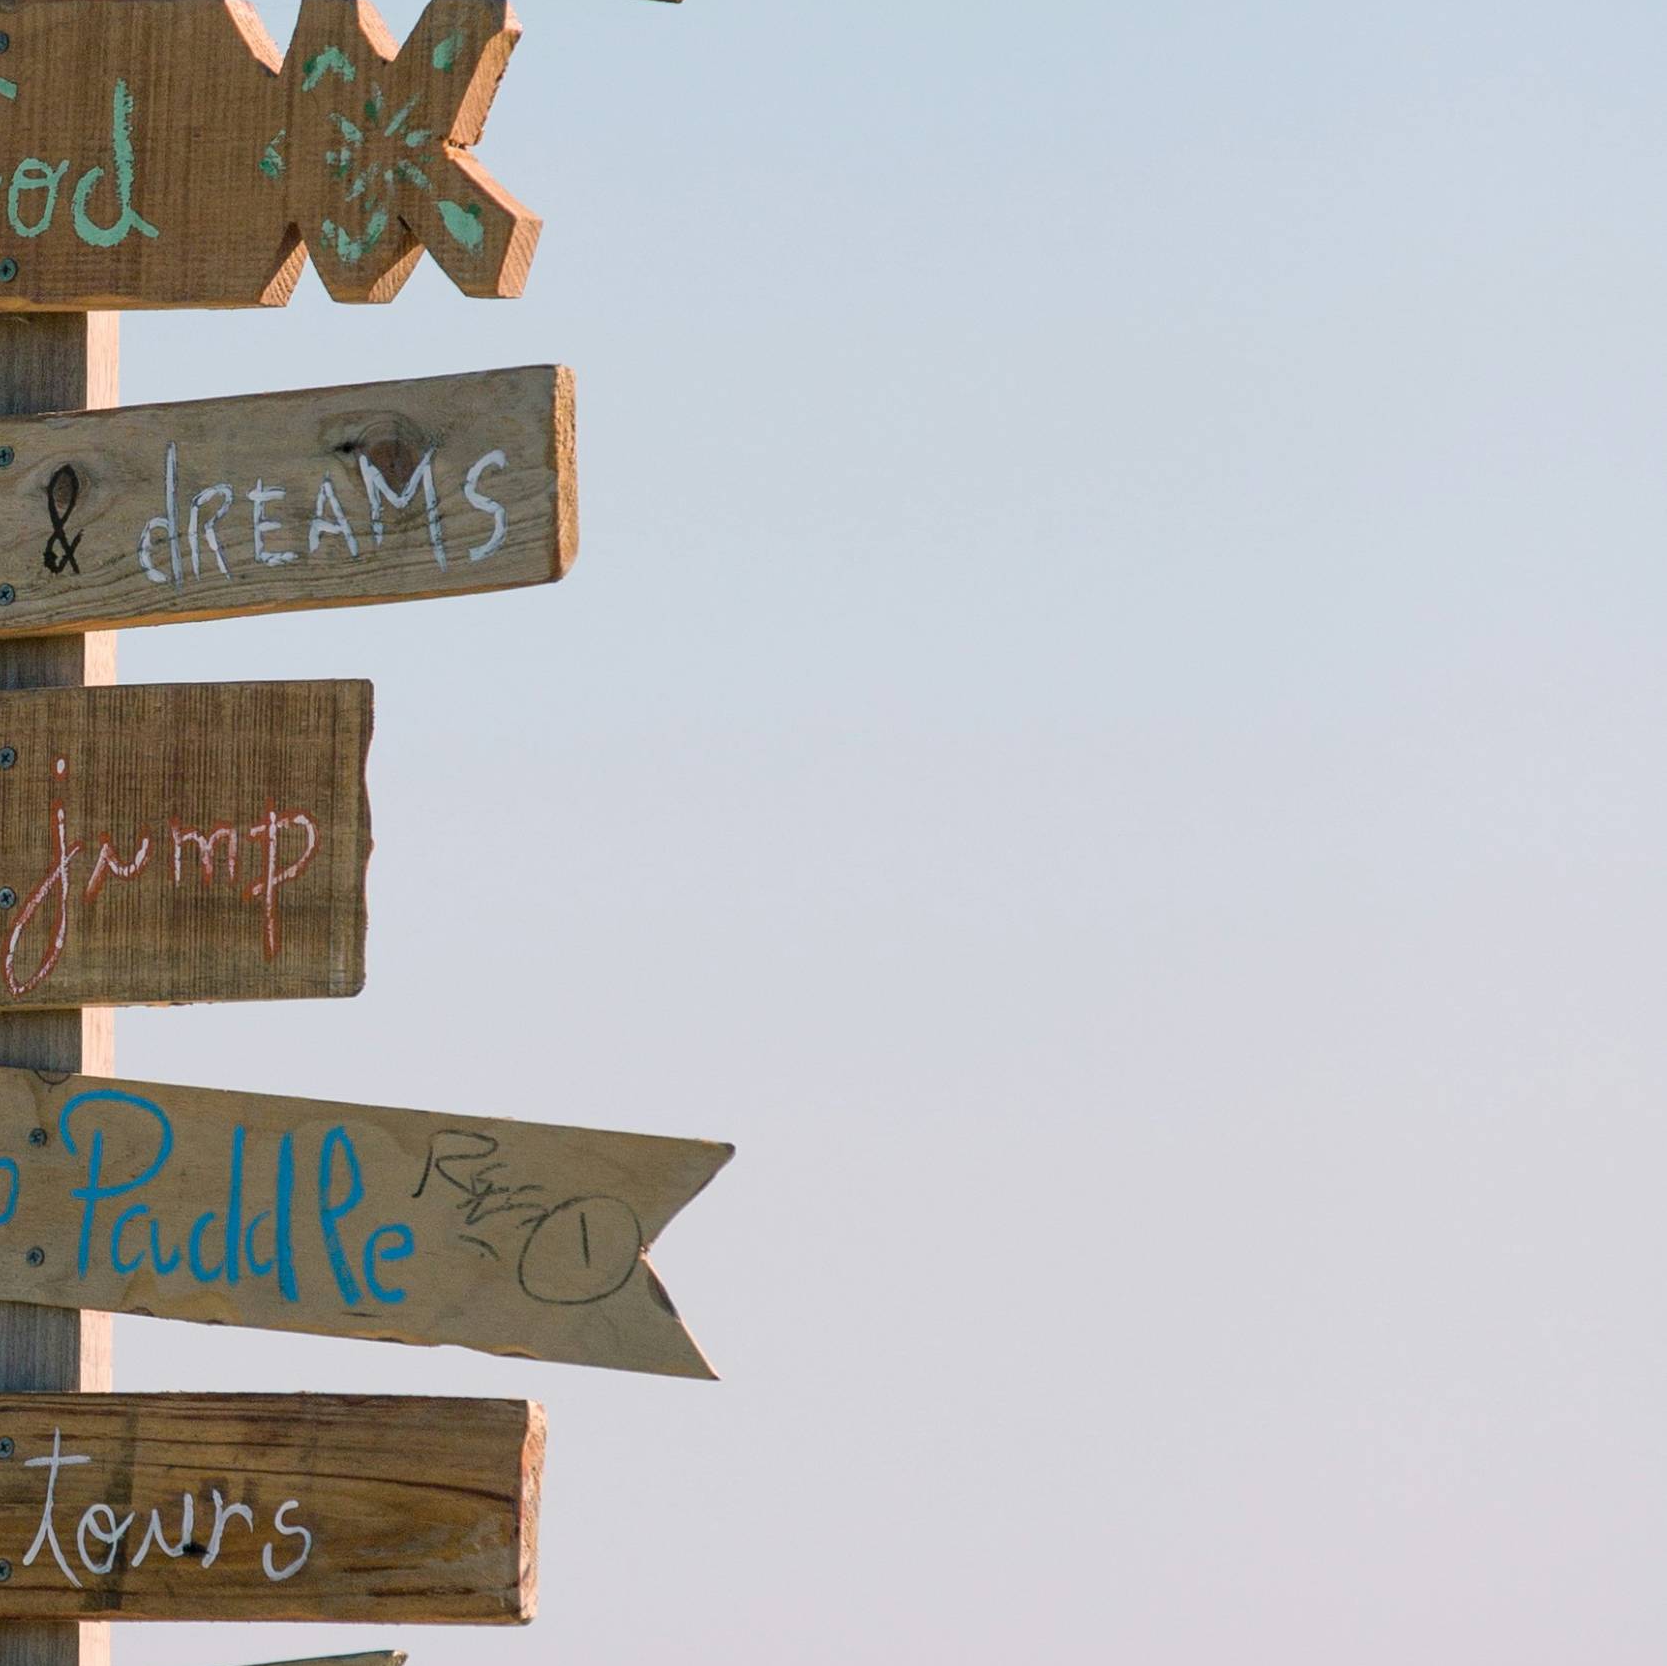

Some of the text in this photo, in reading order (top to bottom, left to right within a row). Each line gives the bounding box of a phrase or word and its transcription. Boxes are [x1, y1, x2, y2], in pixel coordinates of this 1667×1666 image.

[44, 463, 85, 575] &
[2, 758, 318, 997] jump
[60, 1089, 416, 1306] Paddle
